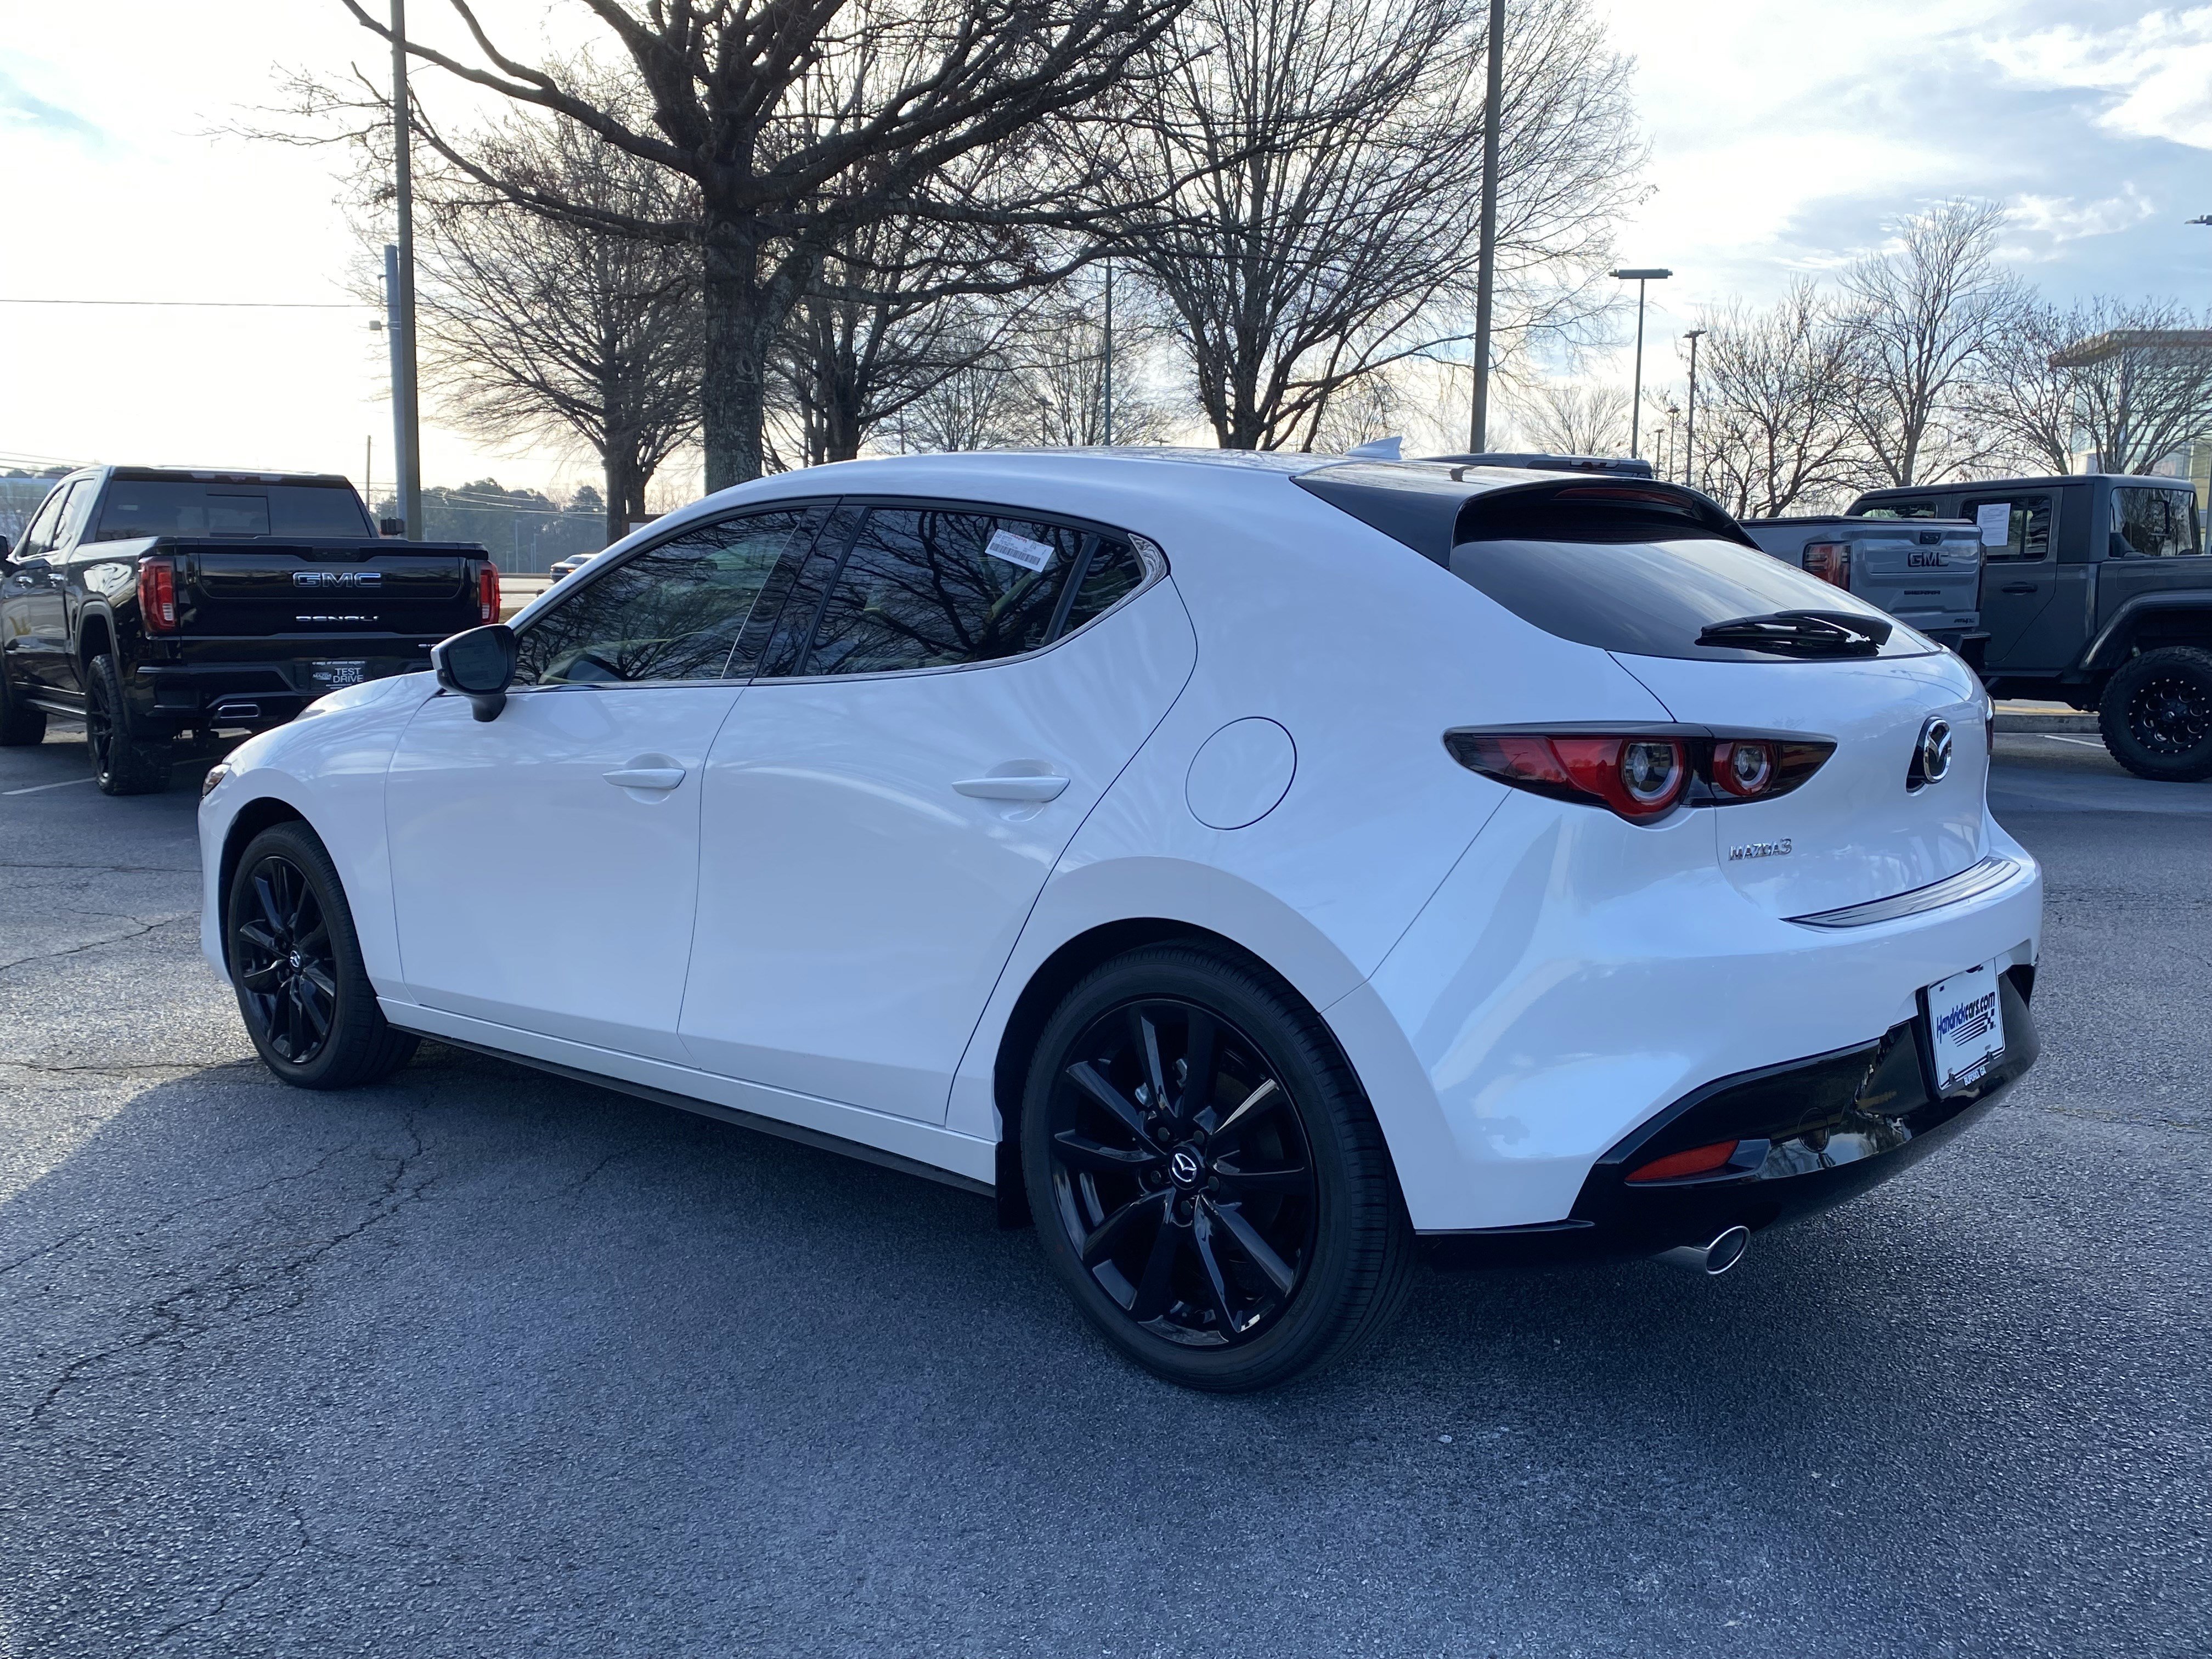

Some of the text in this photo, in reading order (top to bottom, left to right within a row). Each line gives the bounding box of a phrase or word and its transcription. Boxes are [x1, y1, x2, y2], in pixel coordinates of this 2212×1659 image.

[1908, 552, 1949, 567] GMC
[293, 572, 381, 588] GMC
[332, 675, 364, 683] DRIVE
[335, 667, 361, 676] TEST
[1728, 838, 1792, 861] MAZDA3
